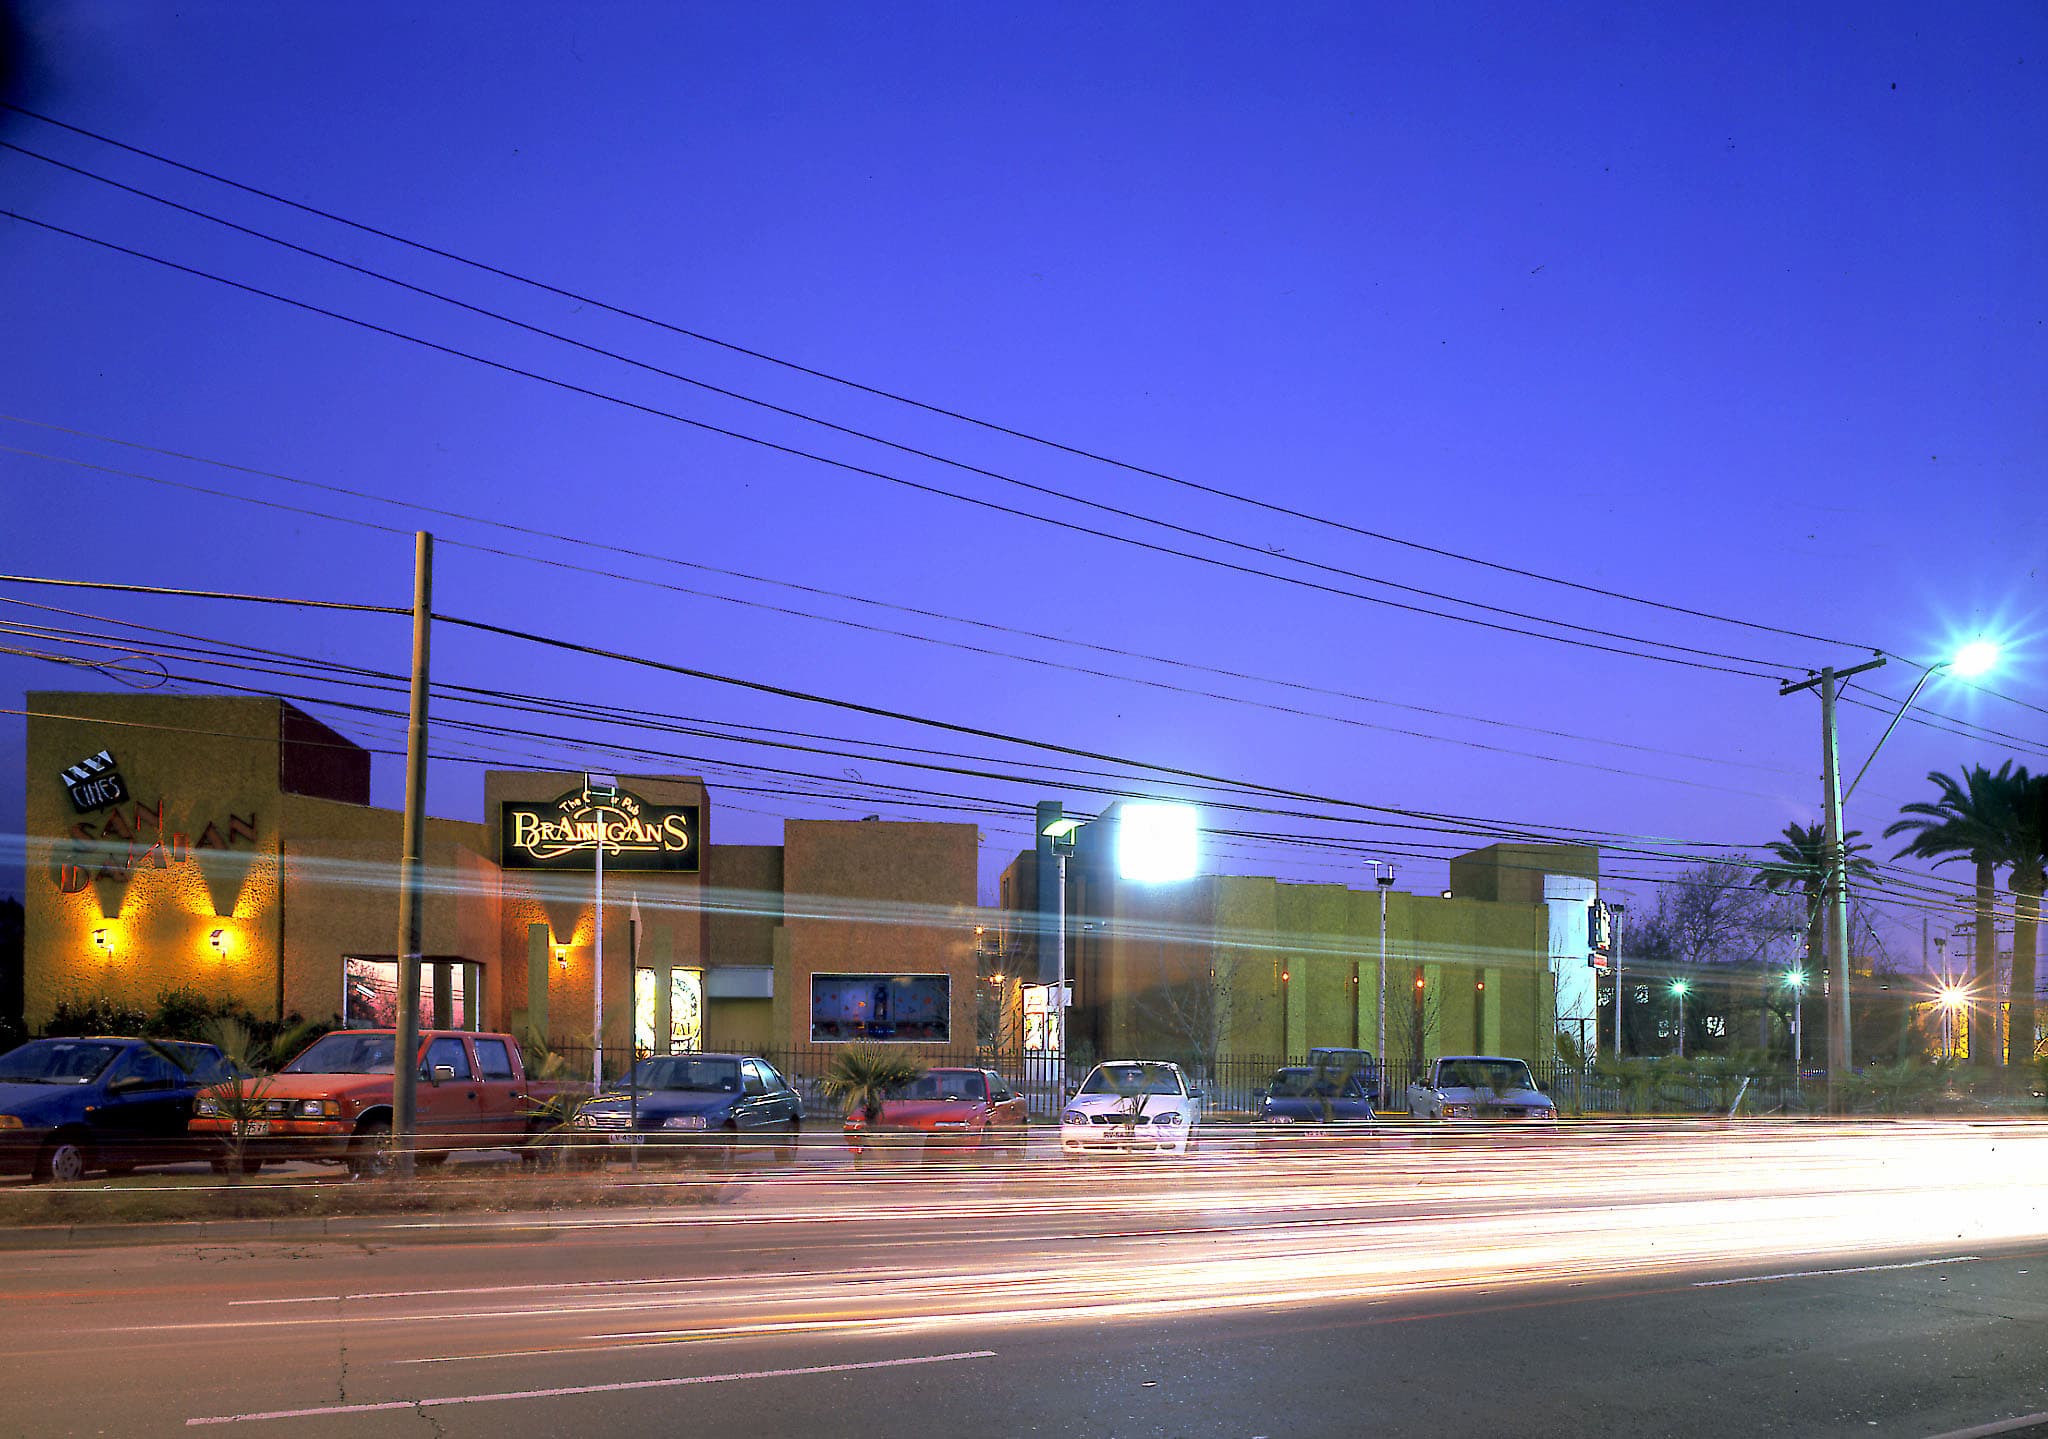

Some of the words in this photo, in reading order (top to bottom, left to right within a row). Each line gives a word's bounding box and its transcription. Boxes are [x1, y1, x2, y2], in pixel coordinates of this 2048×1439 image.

[72, 775, 121, 807] CINES
[559, 797, 582, 813] The
[621, 796, 640, 816] Pub
[71, 800, 164, 853] SAN
